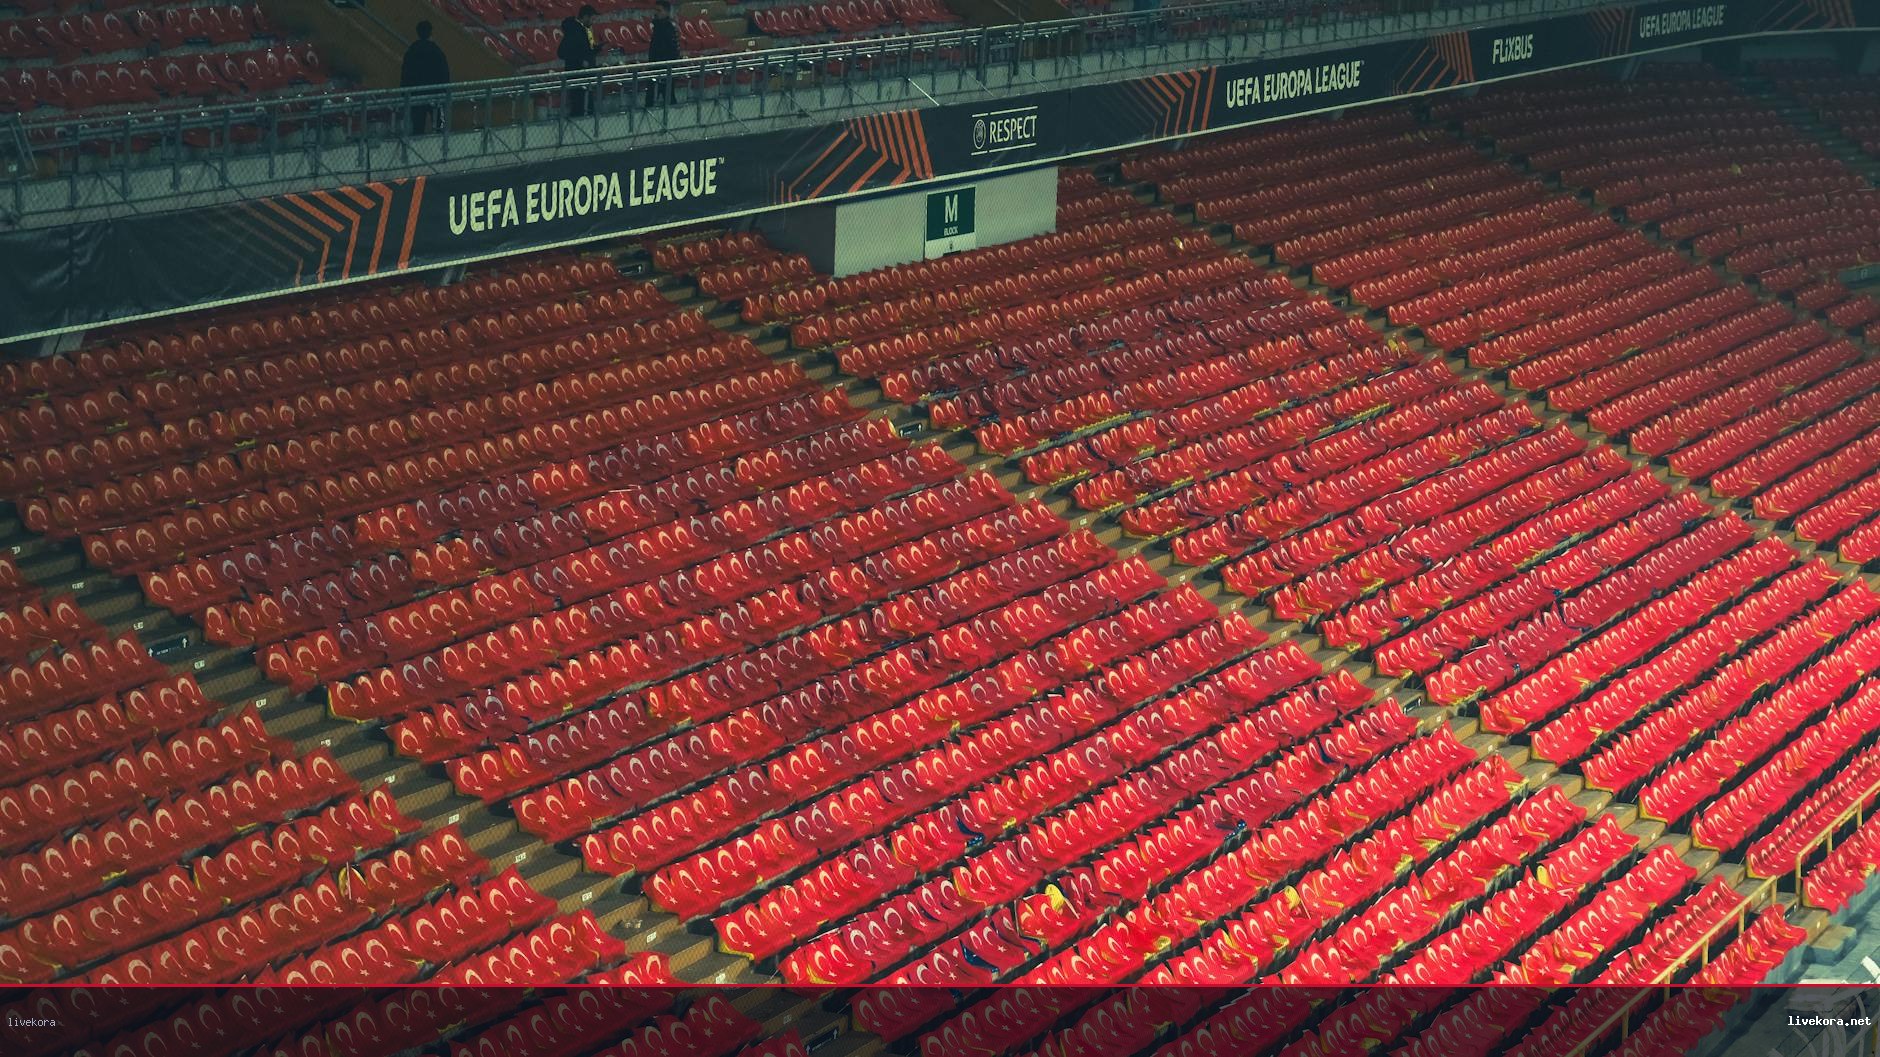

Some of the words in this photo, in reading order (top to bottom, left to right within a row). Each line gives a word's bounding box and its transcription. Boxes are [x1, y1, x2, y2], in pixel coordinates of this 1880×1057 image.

[1639, 13, 1661, 38] UEFA
[1661, 9, 1691, 34] EUROPA
[1226, 76, 1261, 108] UEFA
[1264, 68, 1312, 102] EUROPA
[989, 115, 1037, 143] RESPECT
[450, 188, 519, 235] UEFA
[526, 172, 623, 224] EUROPA
[944, 194, 958, 223] M
[943, 225, 958, 236] BLOCK
